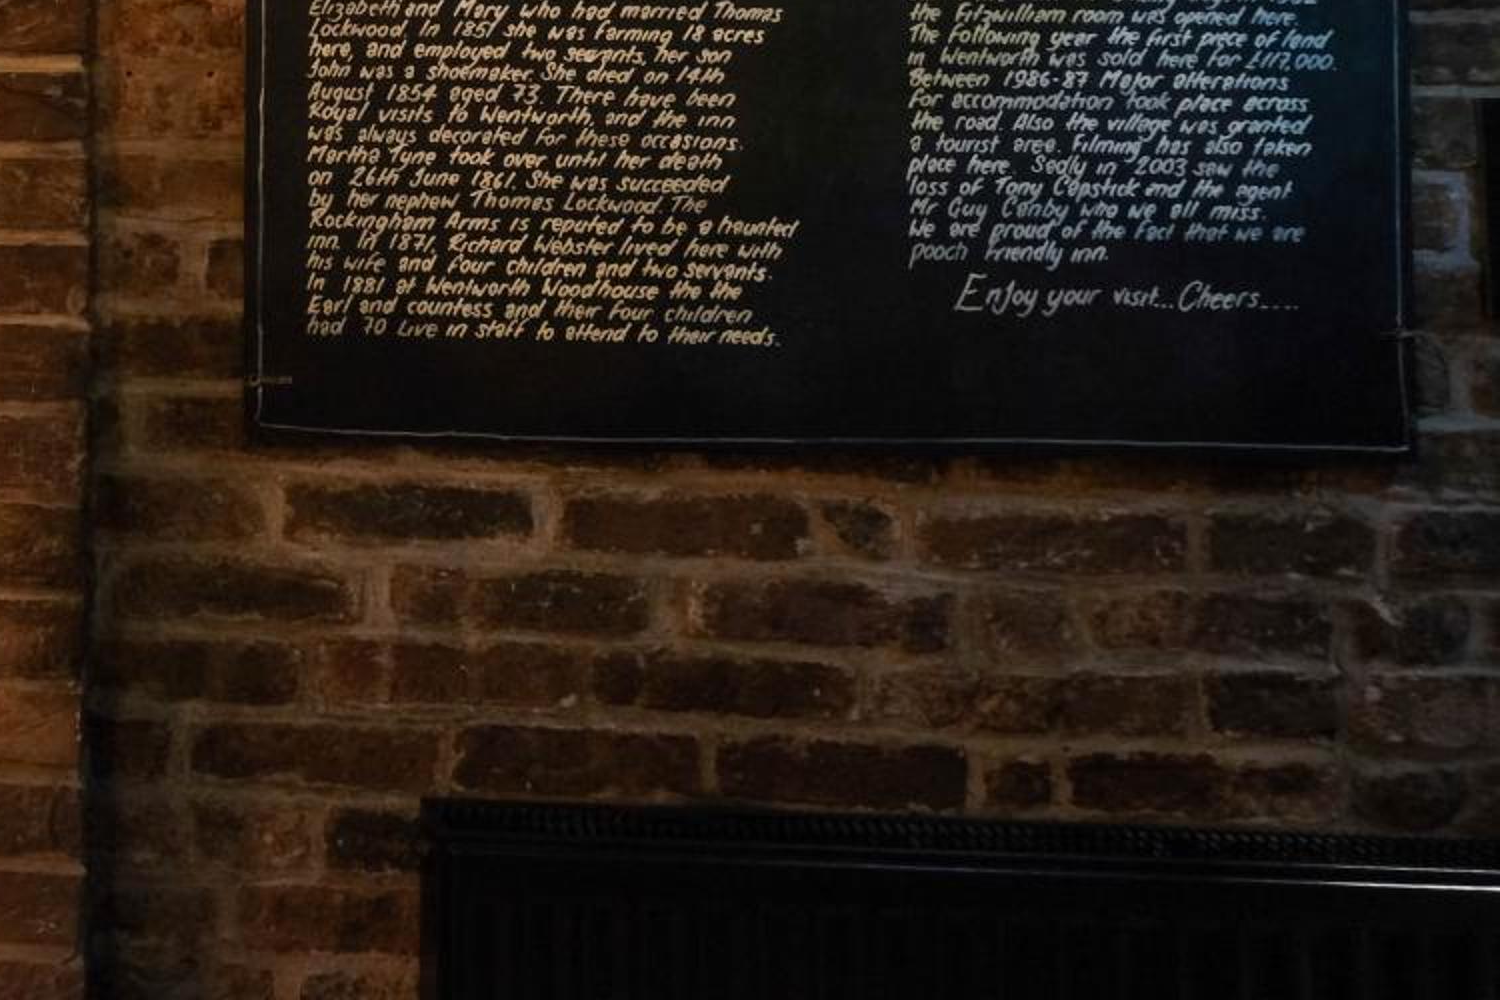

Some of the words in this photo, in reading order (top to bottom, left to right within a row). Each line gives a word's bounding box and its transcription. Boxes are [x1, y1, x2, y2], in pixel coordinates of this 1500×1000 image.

[405, 0, 444, 17] and
[519, 0, 561, 20] who
[572, 0, 617, 21] had
[619, 0, 709, 21] married
[713, 0, 784, 23] Thomas
[308, 79, 375, 103] August
[387, 83, 438, 103] 1854
[450, 82, 504, 109] aged
[555, 84, 617, 106] There
[623, 86, 677, 108] have
[686, 88, 737, 108] been
[1099, 69, 1165, 96] Major
[911, 110, 945, 130] the
[1013, 112, 1055, 131] Also
[1065, 112, 1099, 132] the
[1107, 113, 1172, 142] village
[1179, 118, 1219, 135] was
[1227, 114, 1314, 141] granted
[307, 144, 381, 165] Martha
[389, 144, 437, 171] Tyne
[450, 145, 496, 166] took
[503, 151, 548, 168] over
[555, 150, 607, 169] until
[613, 150, 652, 170] her
[658, 151, 723, 171] death
[906, 153, 957, 181] place
[1096, 162, 1117, 175] in
[1134, 156, 1188, 177] 2003
[1191, 162, 1233, 178] saw
[1241, 158, 1280, 178] the
[910, 197, 940, 215] Mr
[947, 196, 989, 225] Guy
[1127, 202, 1157, 219] we
[1170, 200, 1200, 219] all
[306, 272, 326, 291] In
[343, 275, 386, 294] 1881
[396, 275, 416, 295] at
[425, 275, 531, 297] Wentworth
[541, 278, 659, 299] Woodhouse
[669, 280, 702, 299] the
[710, 280, 743, 300] the
[953, 273, 1039, 318] Enjoy
[1041, 289, 1103, 318] your
[306, 314, 348, 336] had
[363, 315, 387, 336] 70
[446, 324, 468, 339] in
[474, 317, 532, 340] staff
[535, 320, 555, 341] to
[564, 321, 632, 343] attend
[637, 324, 658, 343] to
[668, 326, 716, 344] their
